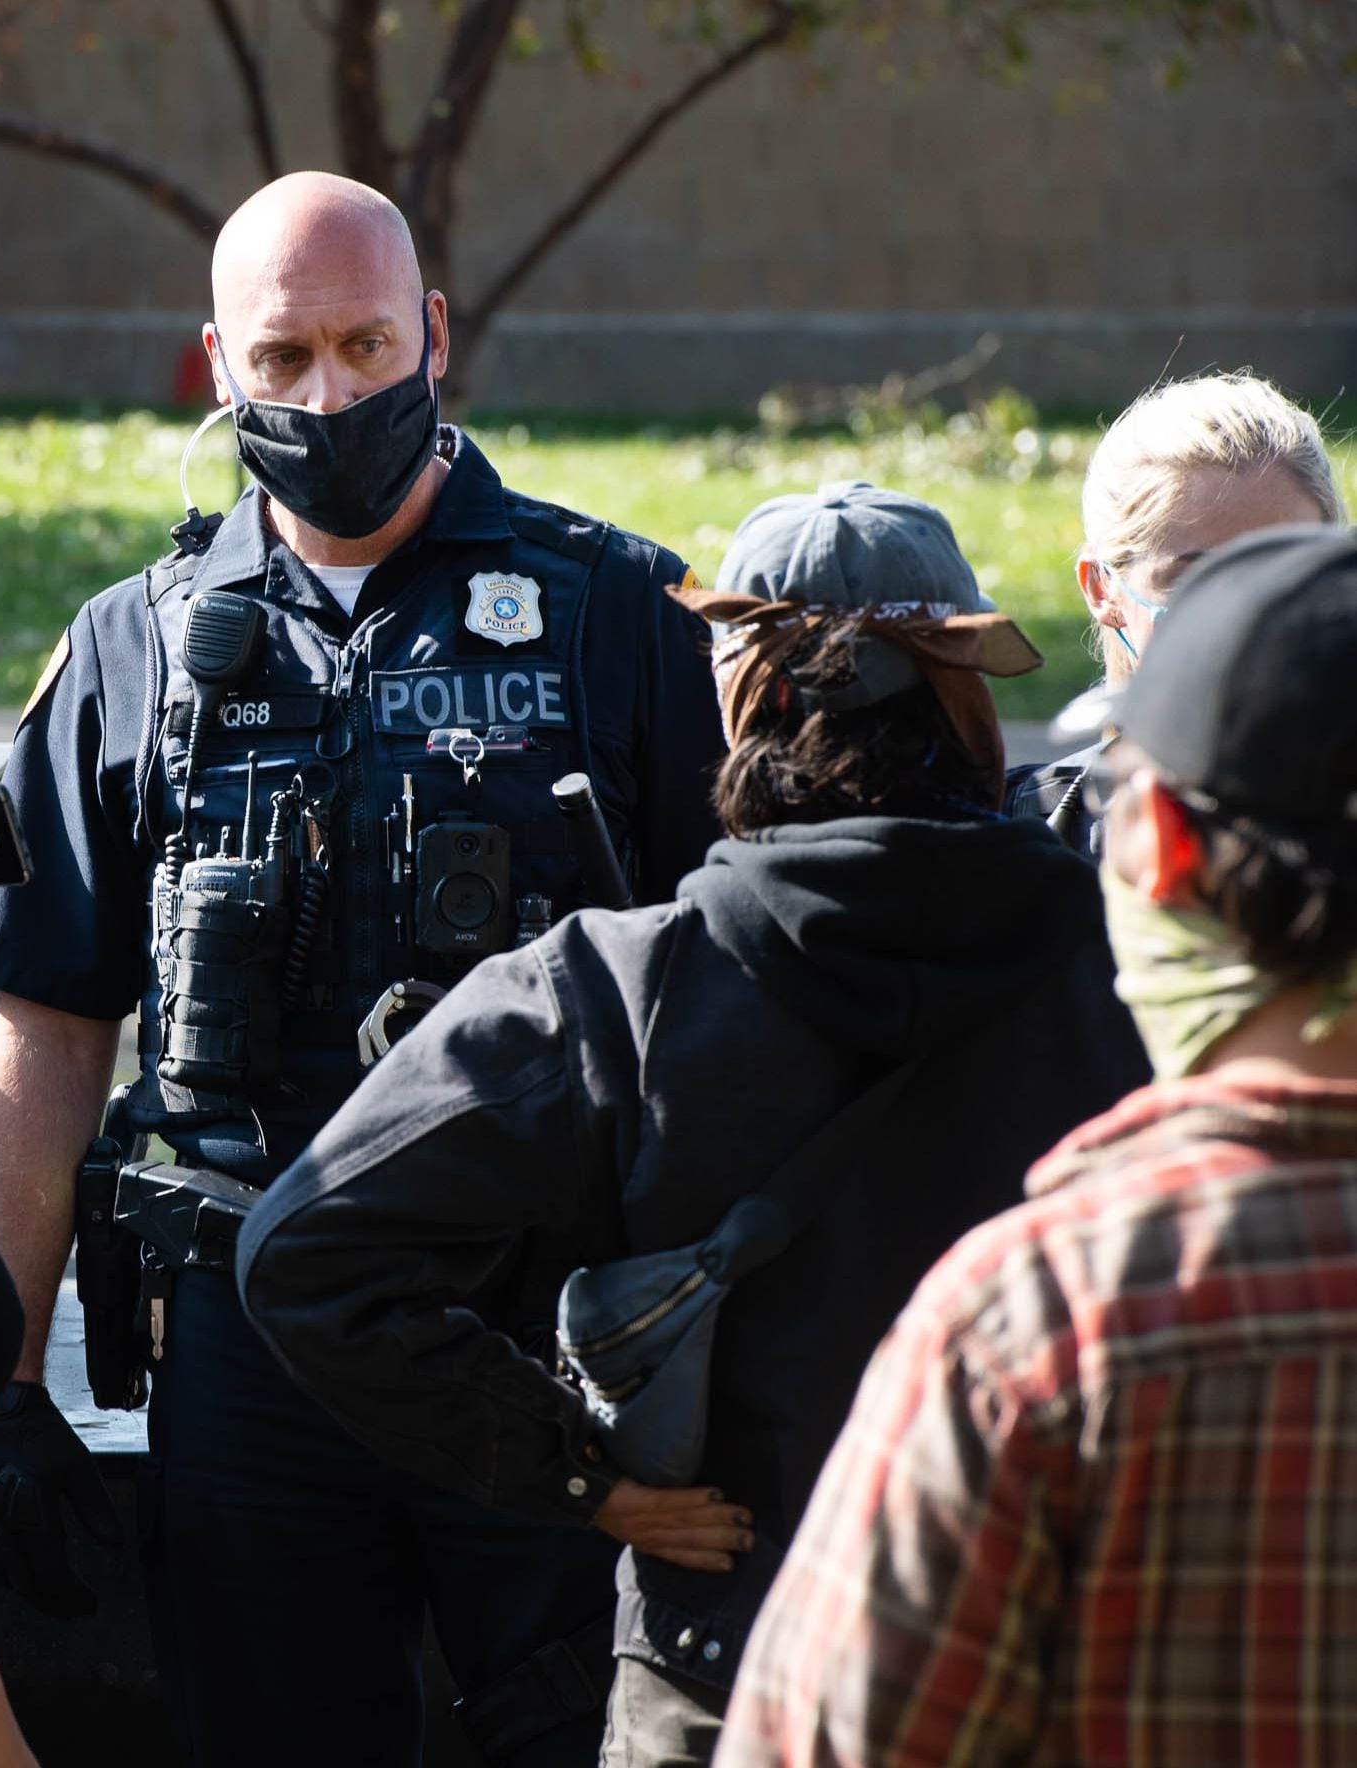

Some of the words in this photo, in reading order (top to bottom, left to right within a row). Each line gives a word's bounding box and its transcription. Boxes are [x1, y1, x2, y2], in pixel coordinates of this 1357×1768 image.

[485, 617, 527, 630] POLICE
[380, 671, 565, 727] POLICE
[223, 702, 270, 727] Q68
